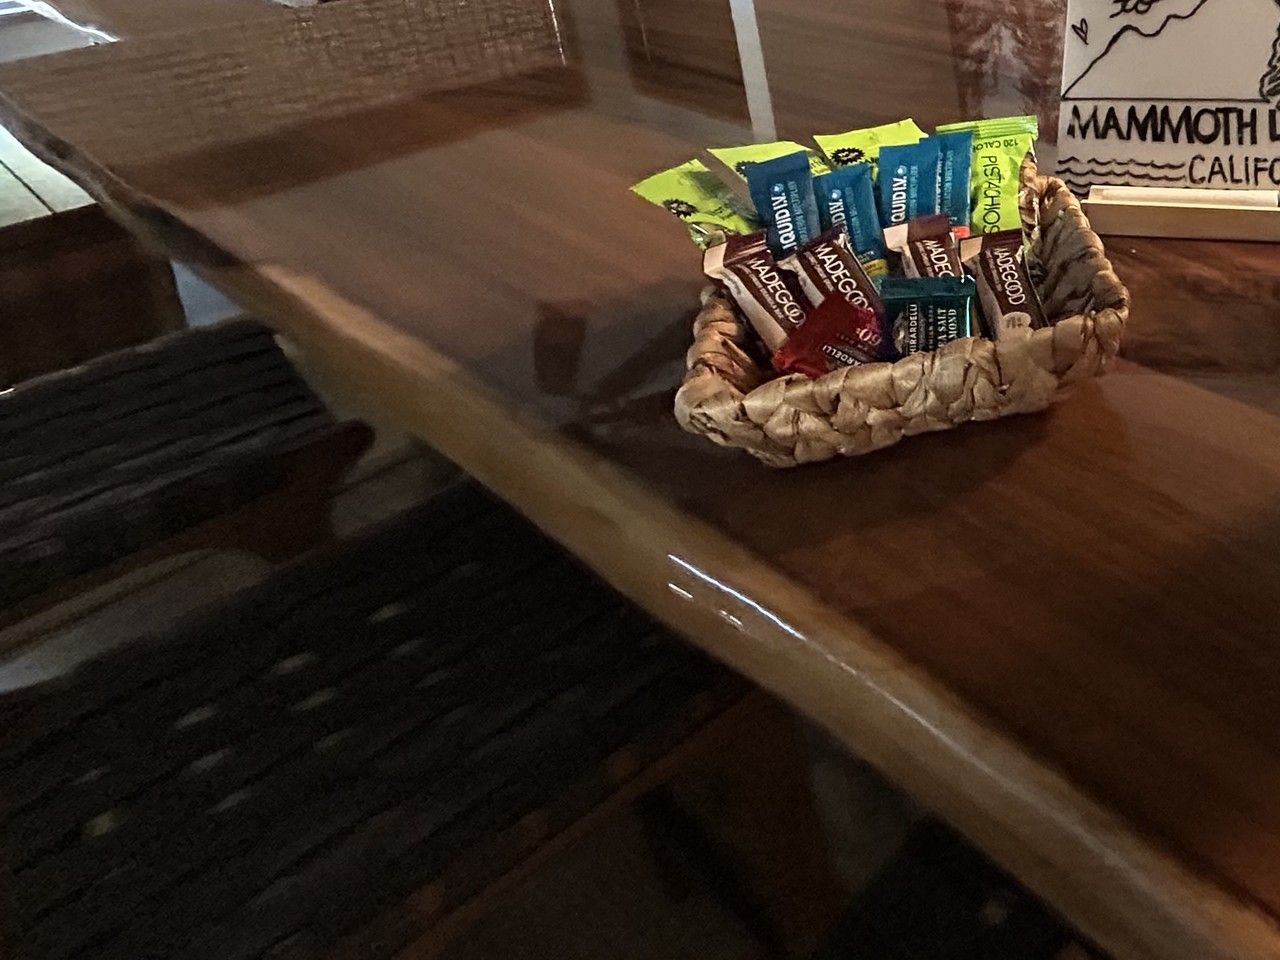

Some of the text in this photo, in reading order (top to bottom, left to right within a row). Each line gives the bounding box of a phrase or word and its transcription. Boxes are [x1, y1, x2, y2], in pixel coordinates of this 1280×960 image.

[1004, 138, 1018, 148] 120
[1066, 104, 1258, 146] MAMMOTH
[891, 191, 907, 224] QUID
[981, 155, 1001, 233] PISTACHIOS
[773, 205, 799, 250] IQUID
[814, 243, 875, 313] MADEGOO
[994, 248, 1026, 305] MADEGOOD
[909, 304, 918, 353] HIRARDELLI
[937, 308, 947, 331] SALT
[947, 309, 957, 339] MOND
[821, 345, 862, 367] ARDELLI
